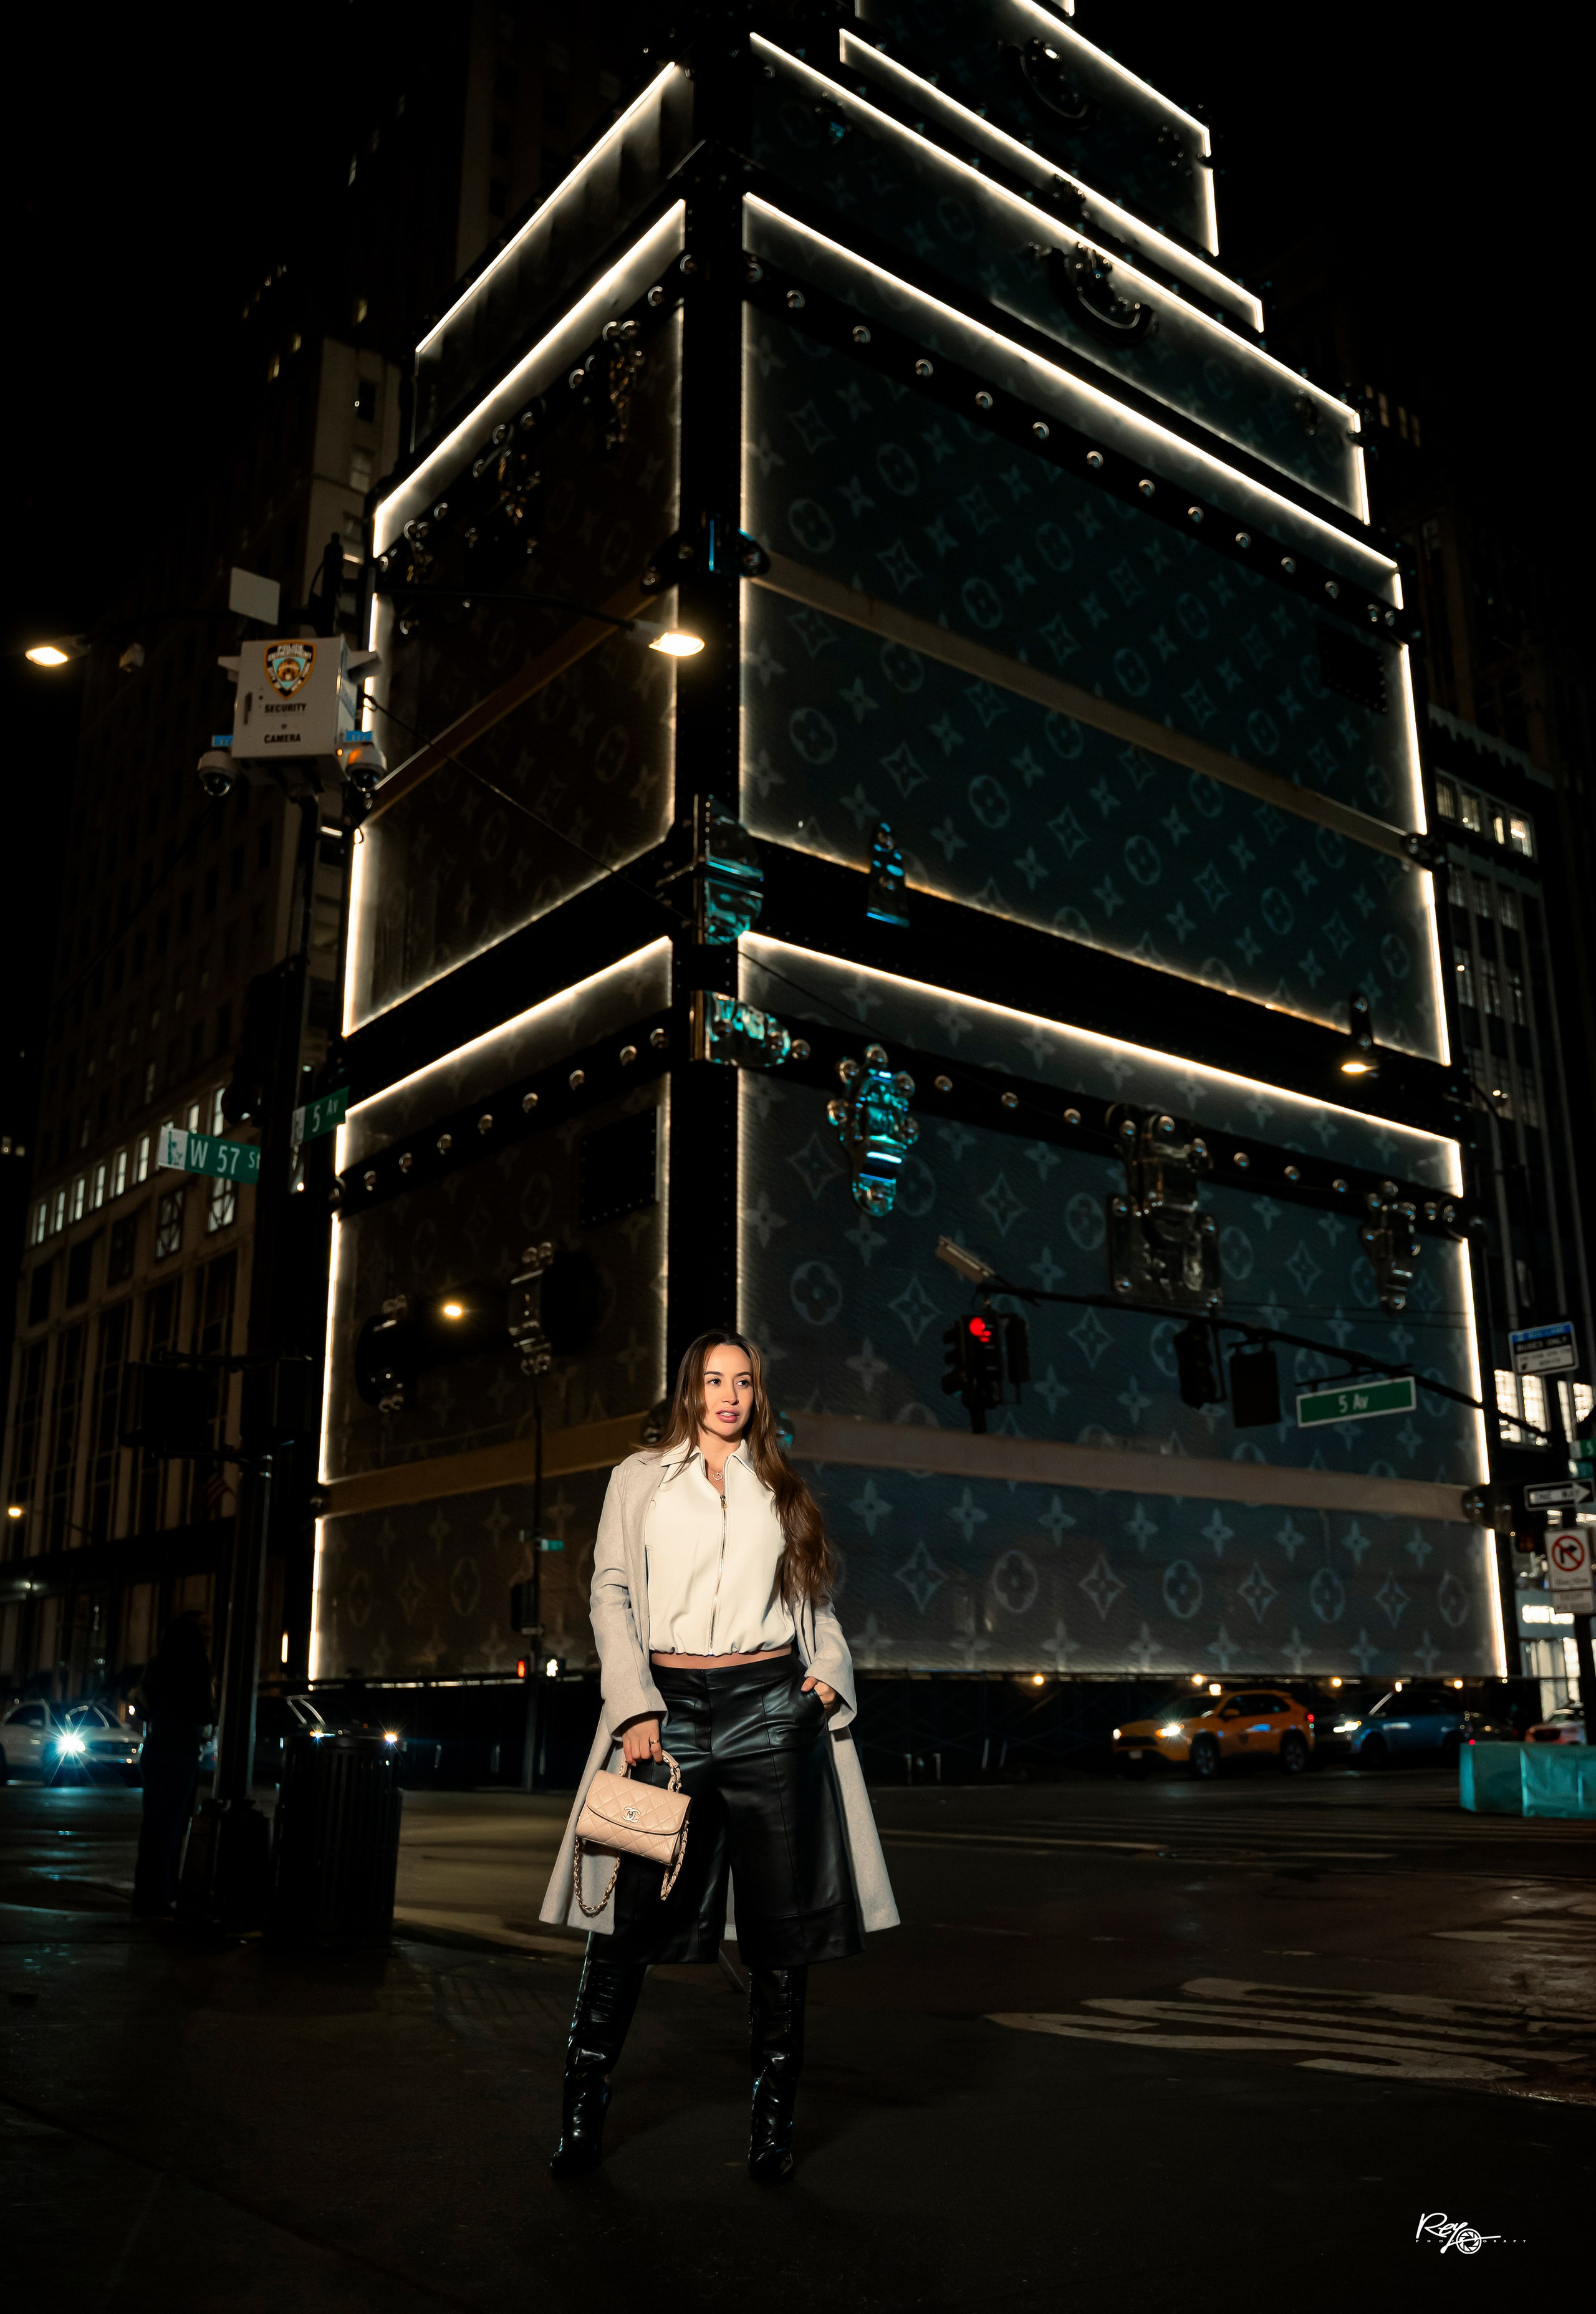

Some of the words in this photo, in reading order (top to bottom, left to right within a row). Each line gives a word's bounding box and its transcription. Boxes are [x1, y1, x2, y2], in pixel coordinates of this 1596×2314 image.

[264, 703, 307, 714] SECURITY
[264, 734, 302, 744] CAMERA
[312, 1105, 321, 1133] 5
[326, 1098, 339, 1116] Av
[190, 1138, 209, 1169] W
[217, 1145, 241, 1175] 57
[1338, 1395, 1348, 1414] 5
[1352, 1393, 1369, 1410] Av
